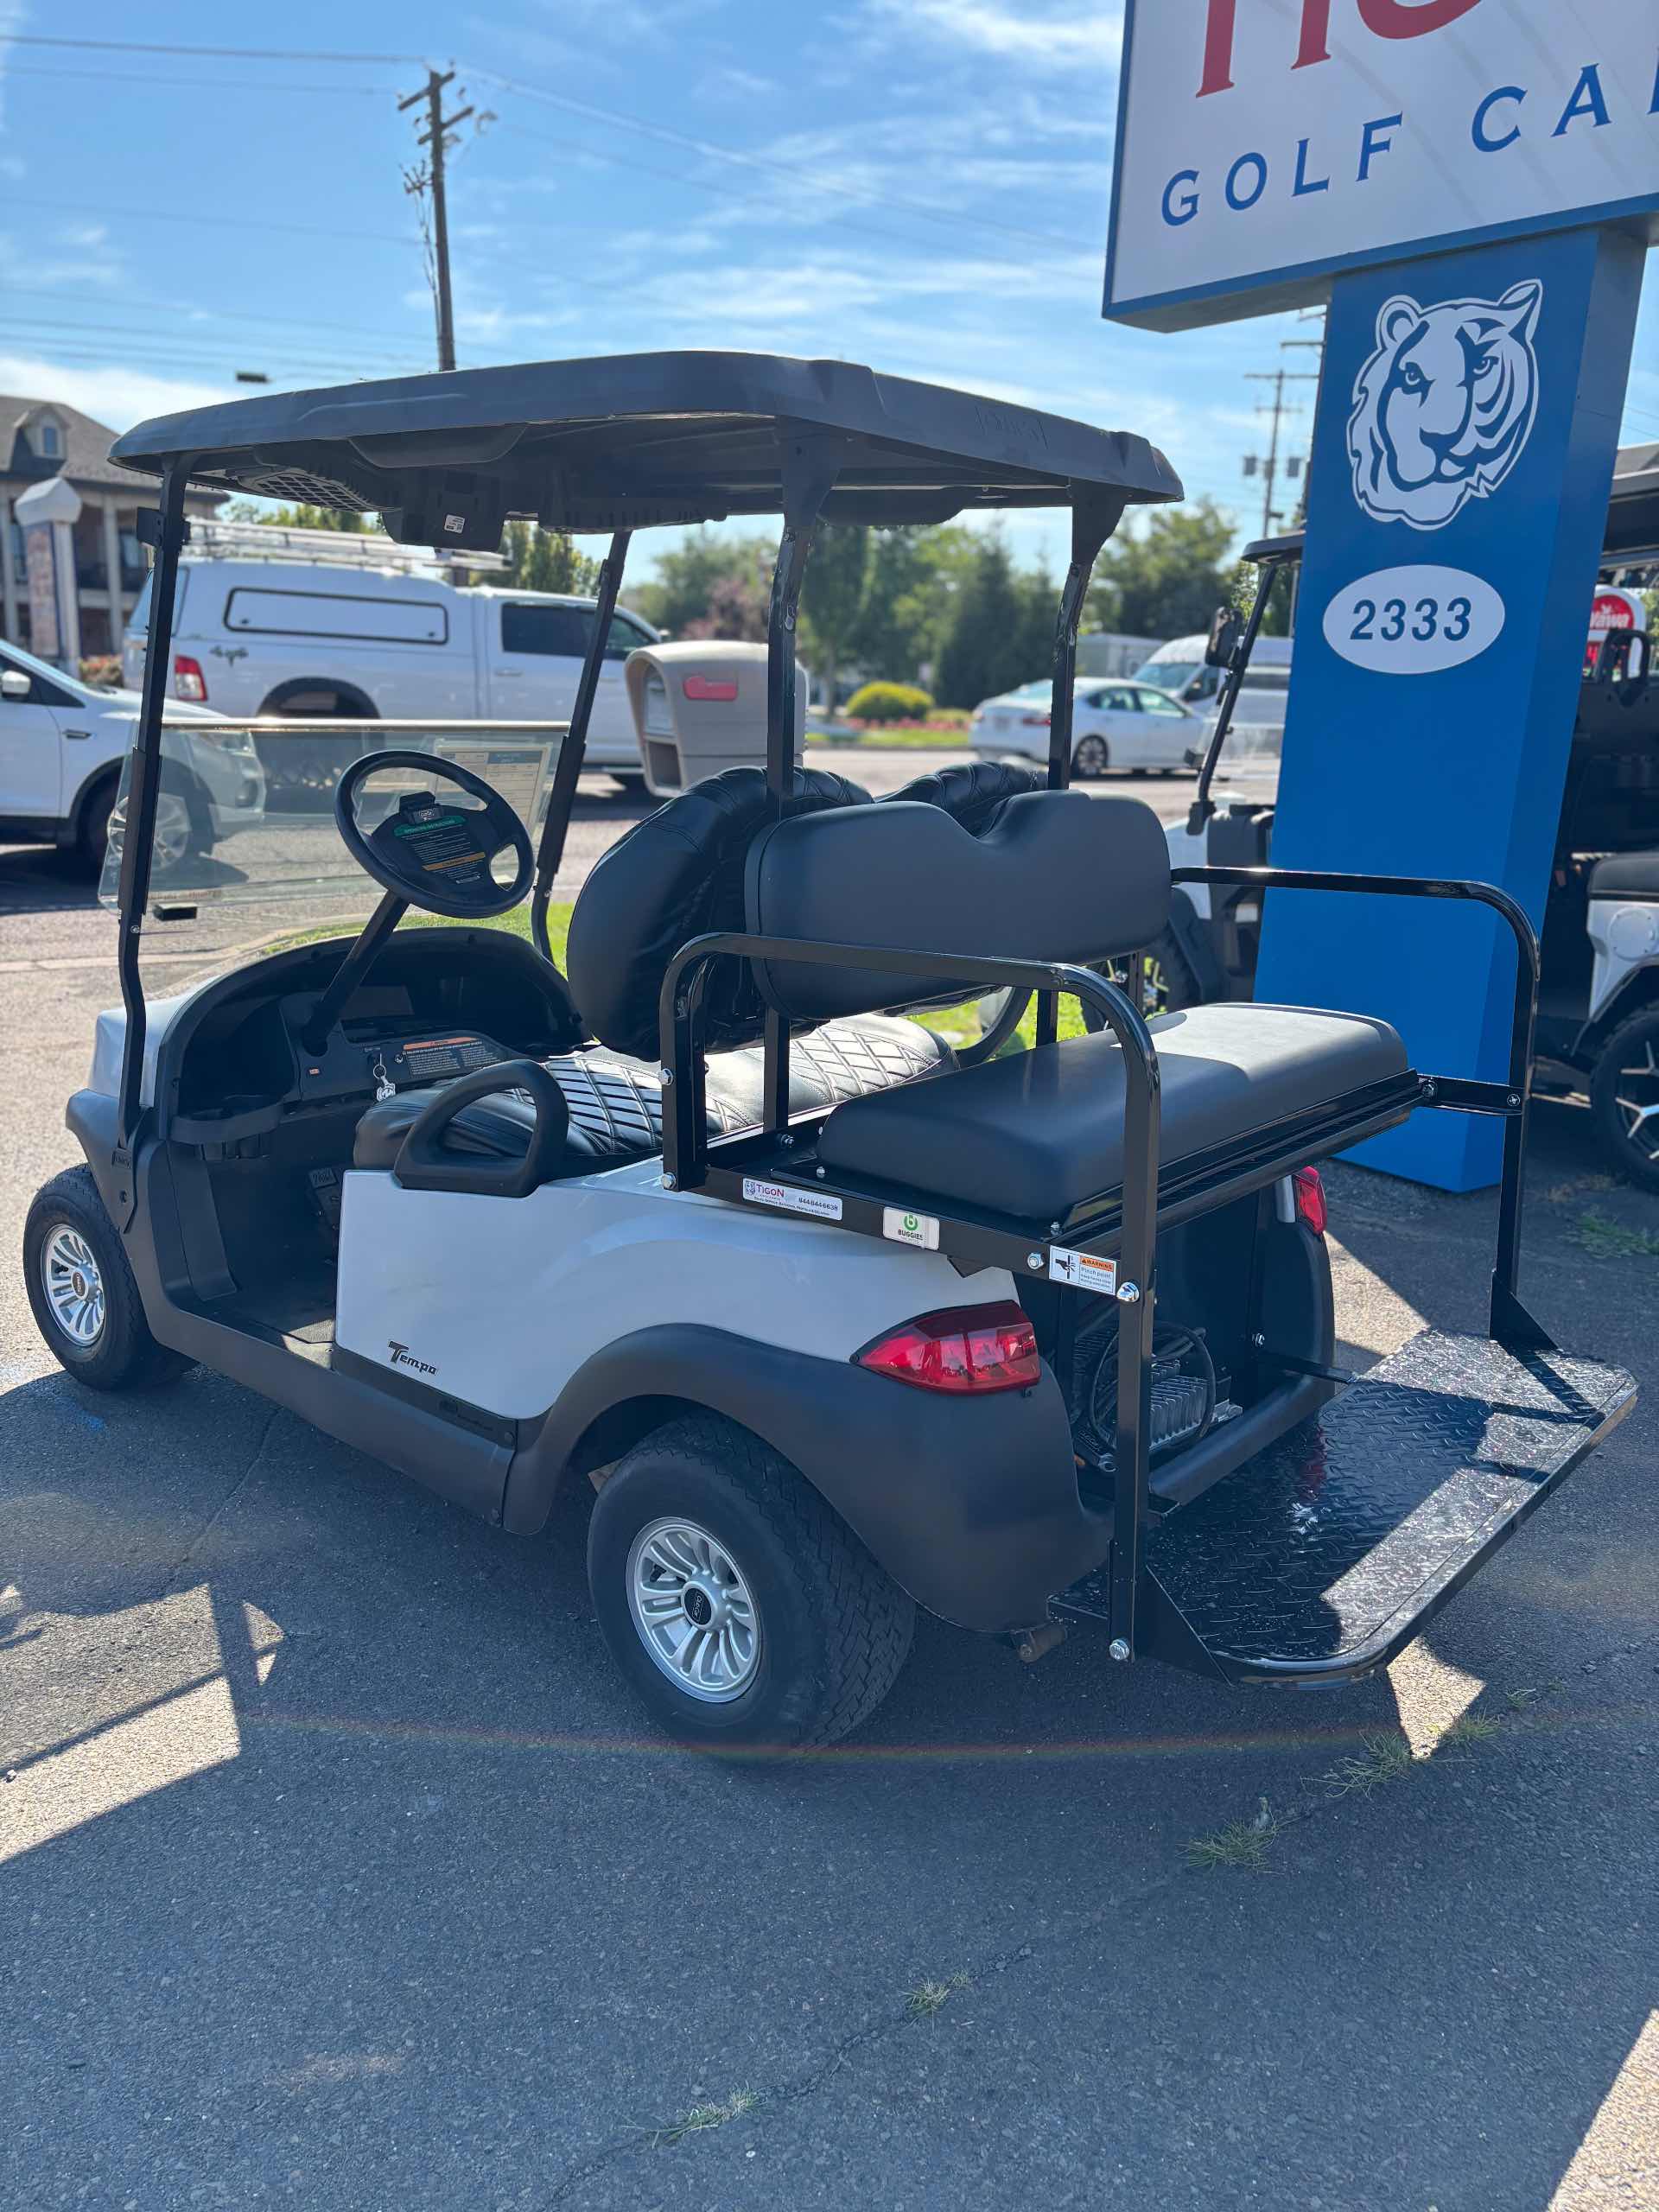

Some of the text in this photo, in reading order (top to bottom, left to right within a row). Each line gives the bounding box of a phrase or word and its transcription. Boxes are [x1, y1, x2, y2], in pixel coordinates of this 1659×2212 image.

[1160, 111, 1403, 226] GOLF
[1471, 47, 1659, 153] CA
[1350, 596, 1471, 641] 2333
[1087, 1258, 1113, 1270] WARNING
[388, 1340, 437, 1376] Tempo
